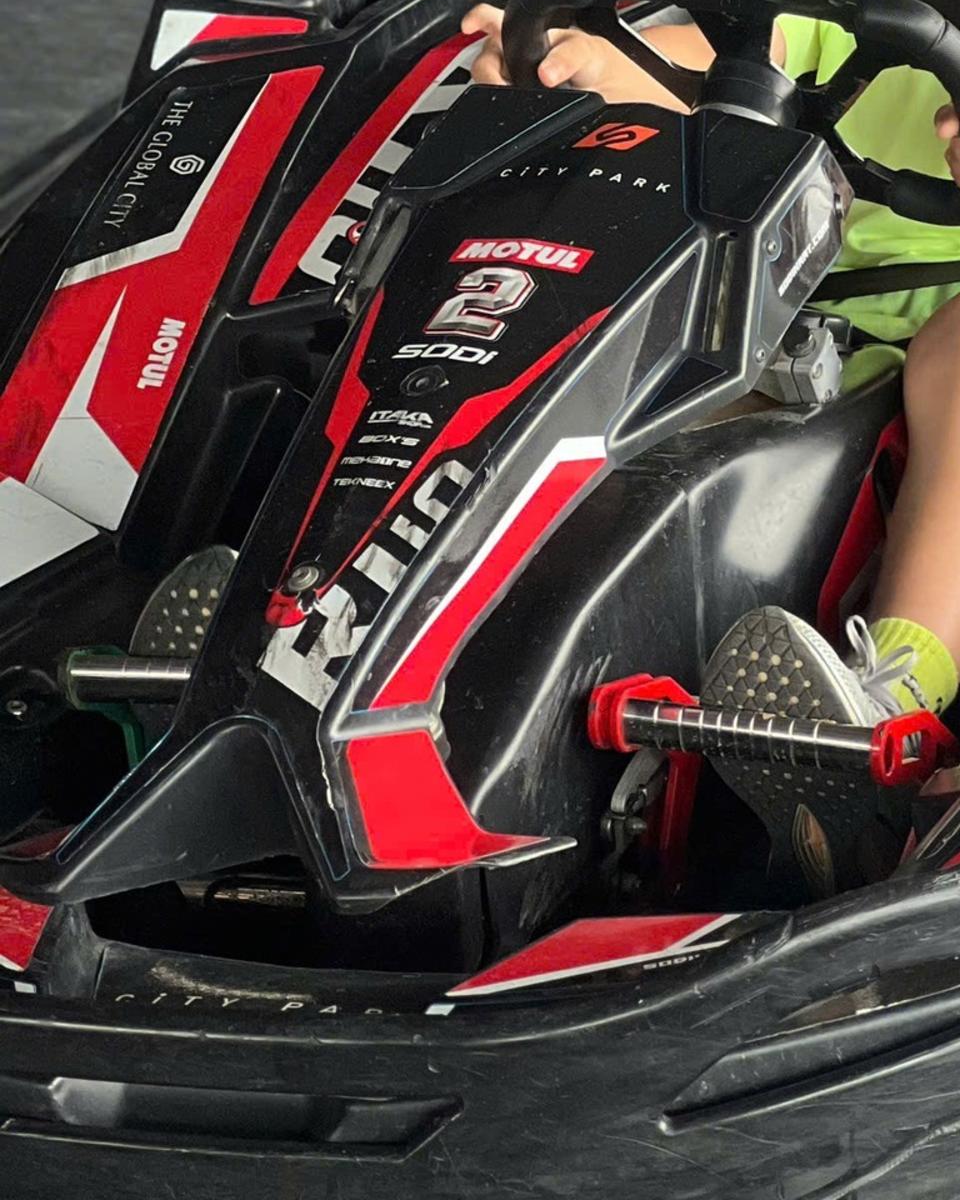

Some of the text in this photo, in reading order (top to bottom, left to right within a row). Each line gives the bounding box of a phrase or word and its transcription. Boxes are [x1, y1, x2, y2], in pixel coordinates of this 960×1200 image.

[104, 101, 194, 228] THE GLOBAL CITY
[589, 168, 671, 193] PARK
[456, 241, 582, 268] MOTUL
[422, 267, 539, 341] 2
[136, 317, 186, 389] MOTUL
